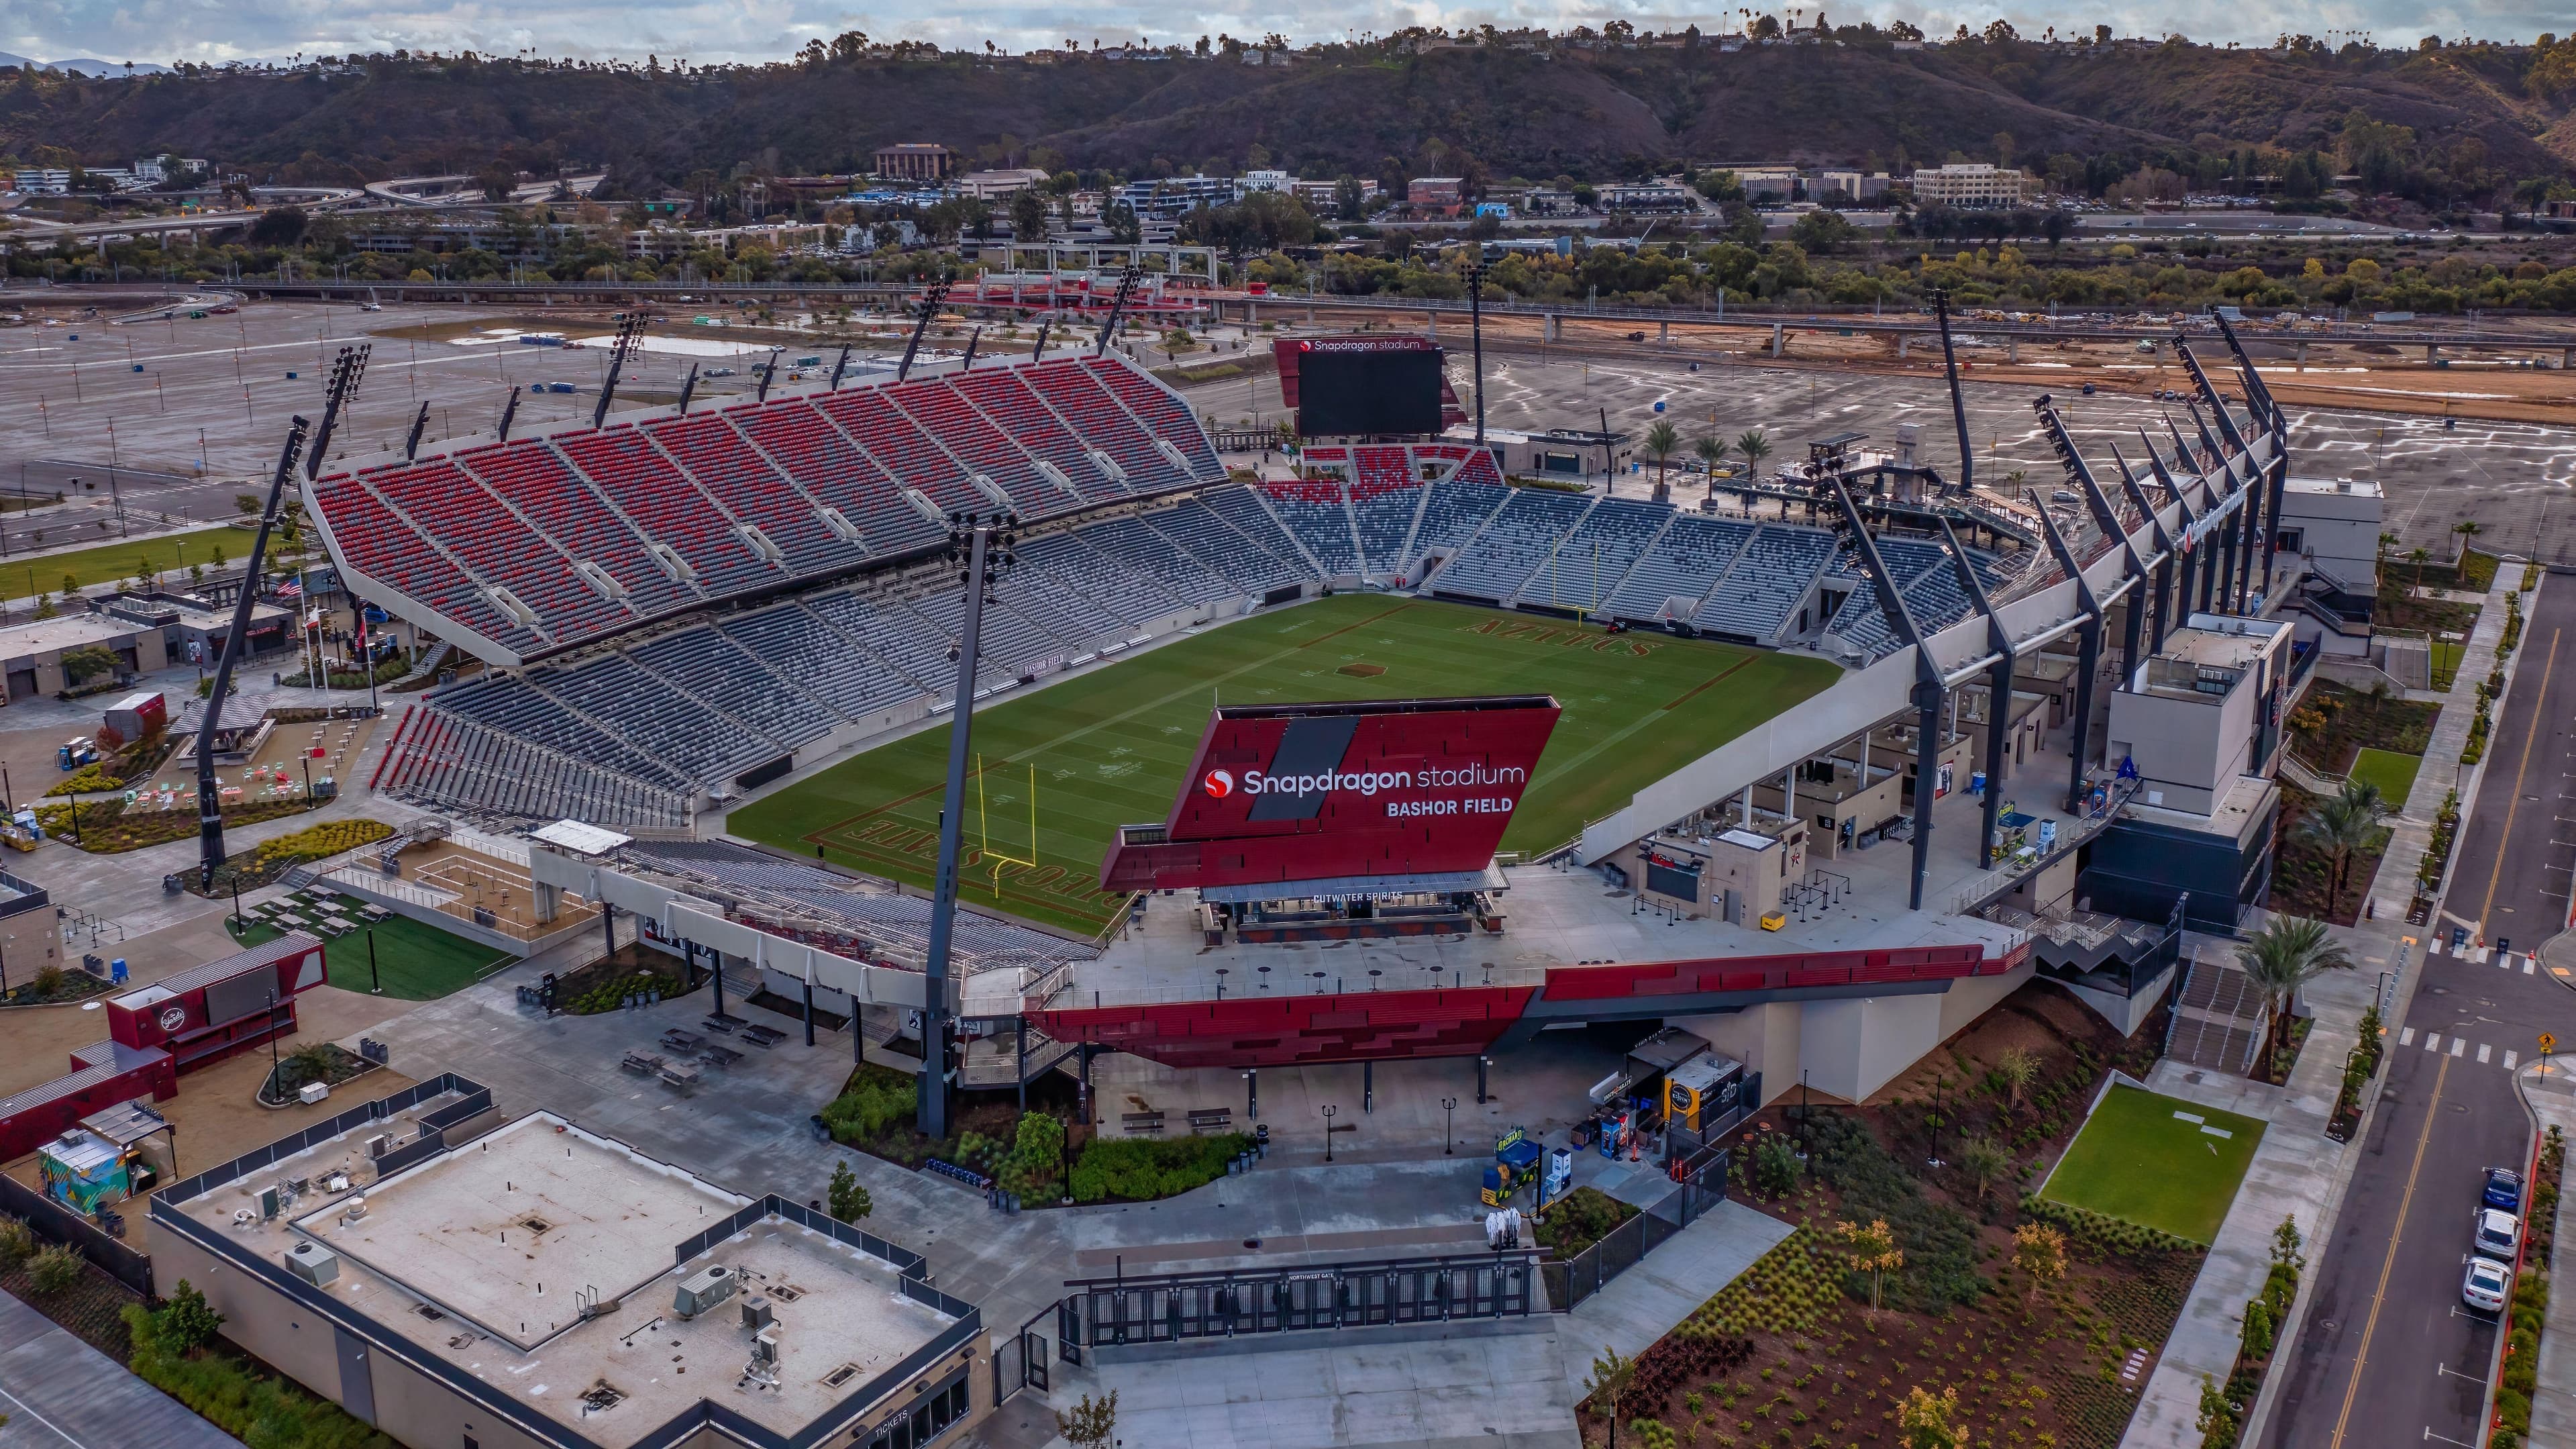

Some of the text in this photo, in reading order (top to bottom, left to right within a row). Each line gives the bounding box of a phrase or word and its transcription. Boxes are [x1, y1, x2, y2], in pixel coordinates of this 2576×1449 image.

[1315, 340, 1420, 352] Snapdragon stadium
[1455, 619, 1665, 657] AZTECS
[1244, 762, 1524, 798] Snapdragon stadium
[1388, 797, 1512, 817] BASHOR FIELD
[1313, 891, 1404, 903] CUTWATER SPIRITS
[1288, 1273, 1321, 1281] NORTHWEST
[875, 1409, 908, 1438] TICKETS
